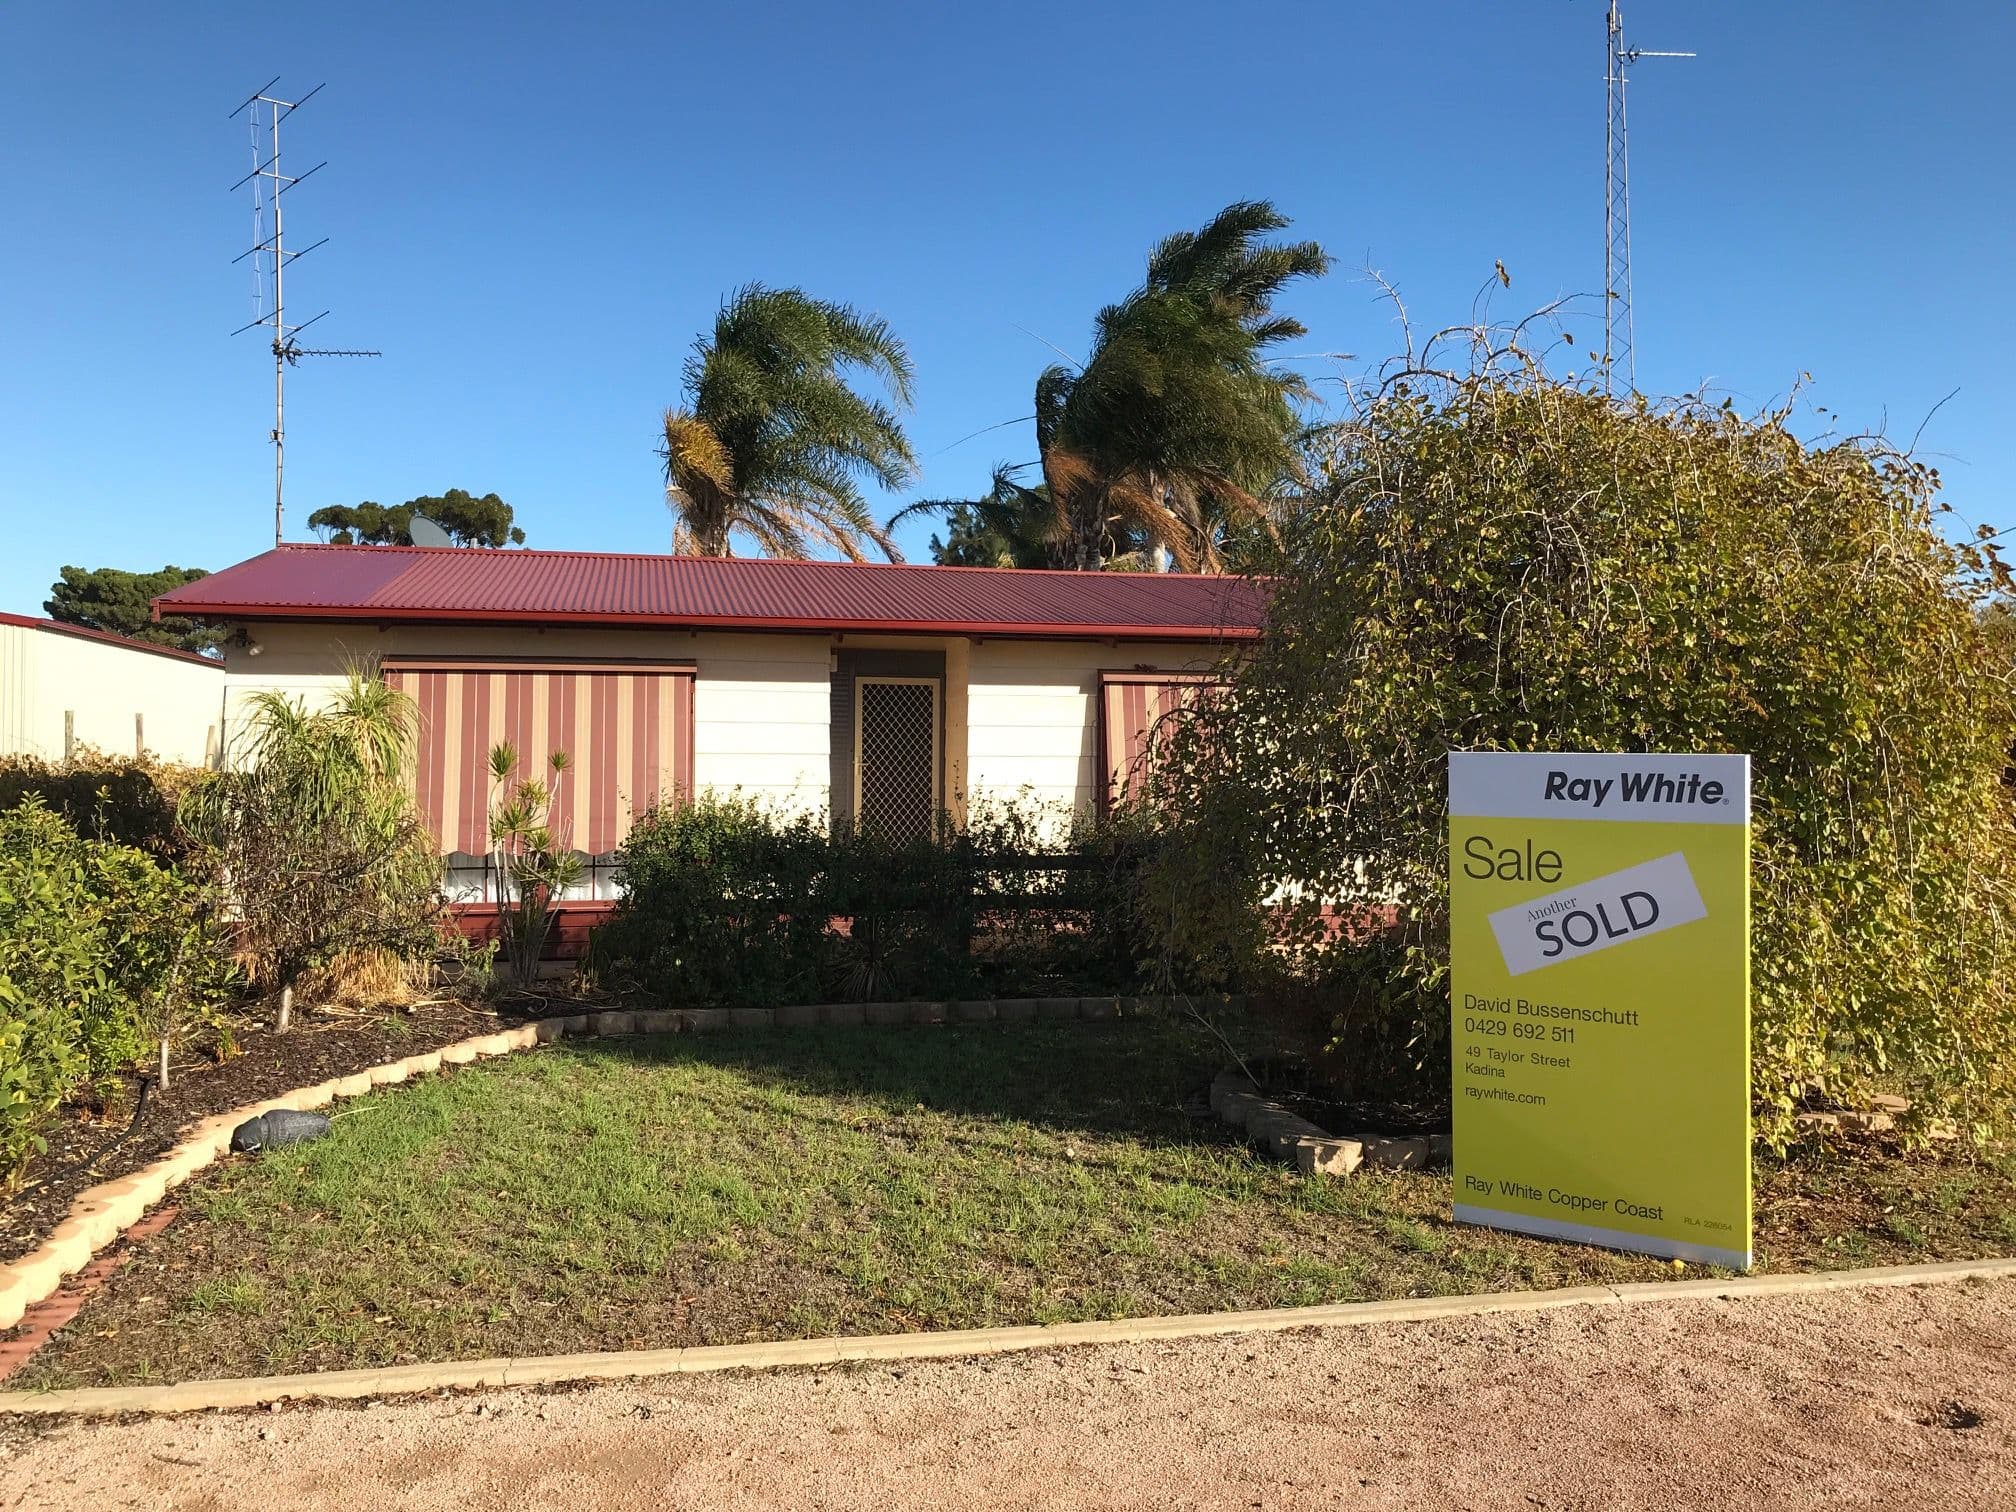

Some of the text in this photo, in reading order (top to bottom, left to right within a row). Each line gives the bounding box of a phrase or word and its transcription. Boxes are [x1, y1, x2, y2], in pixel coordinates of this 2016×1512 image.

[1545, 772, 1725, 807] Ray White
[1464, 836, 1562, 883] Sale
[1528, 897, 1577, 922] Another
[1535, 891, 1660, 957] SOLD
[1465, 994, 1638, 1027] David Bussenschutt
[1465, 1018, 1573, 1043] 0429 692 511
[1466, 1046, 1570, 1067] 49 Taylor Street
[1466, 1061, 1505, 1078] Kadina
[1466, 1087, 1545, 1105] raywhite.com
[1466, 1176, 1663, 1220] Ray White Copper Coast
[1683, 1216, 1701, 1227] RLA
